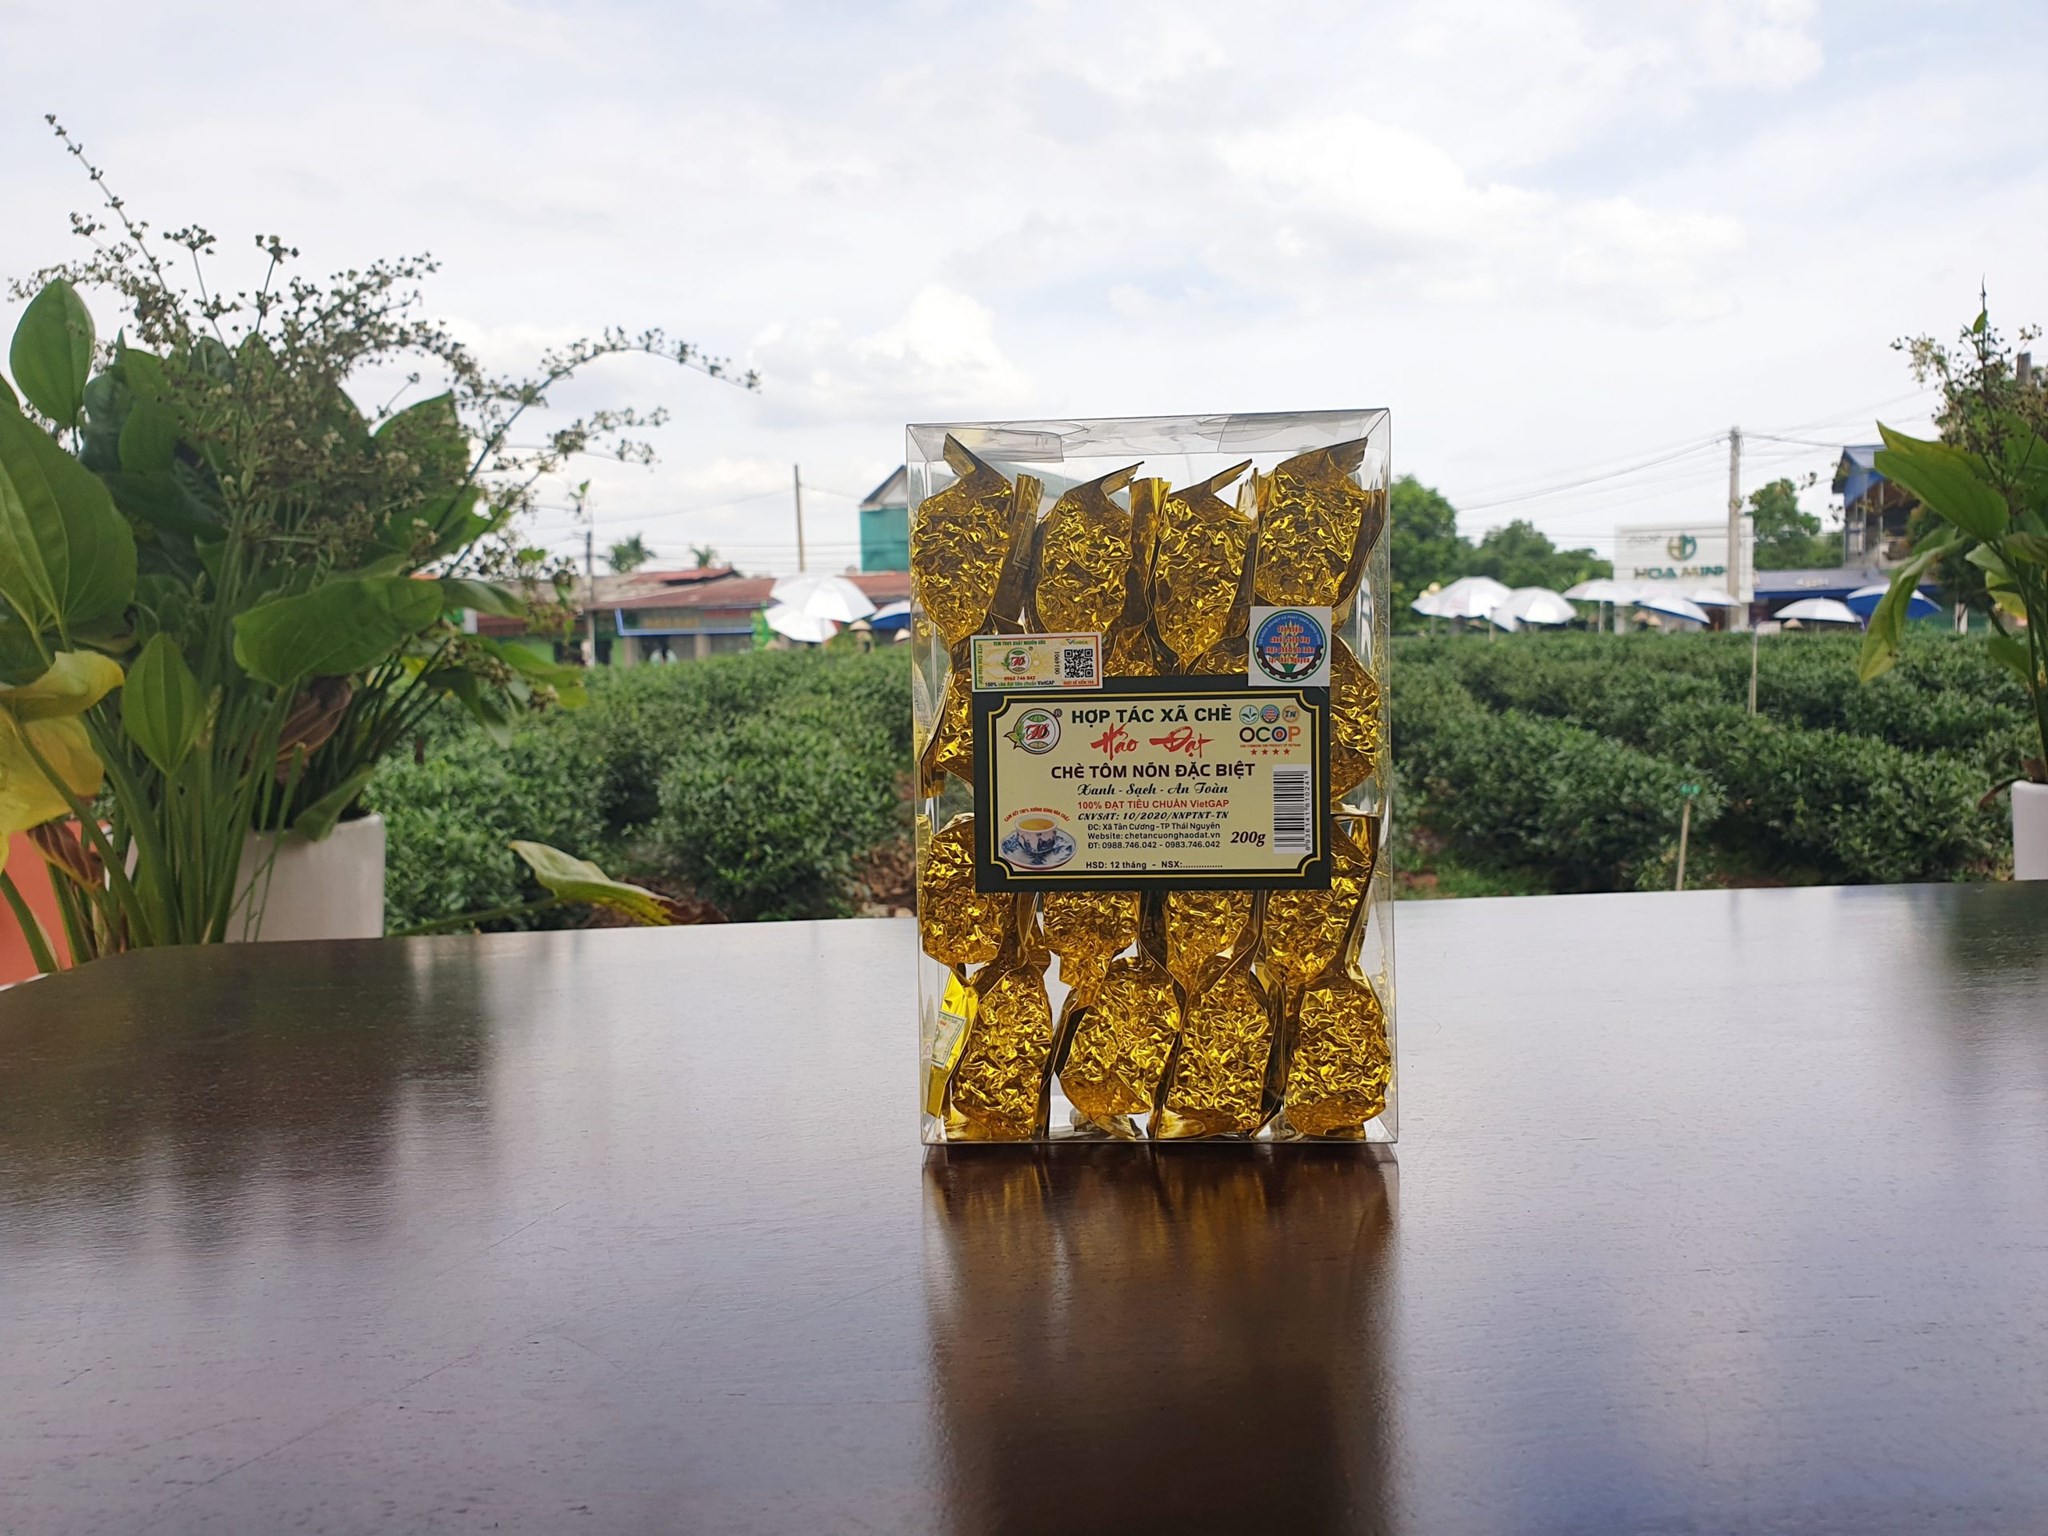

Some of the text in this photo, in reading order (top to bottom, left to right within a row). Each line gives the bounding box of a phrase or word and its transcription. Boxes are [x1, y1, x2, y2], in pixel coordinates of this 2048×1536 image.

[1634, 567, 1677, 579] HOA
[1072, 704, 1232, 728] HỢP TÁC XÃ CHÈ
[1239, 726, 1301, 743] OCOP
[1051, 760, 1255, 780] CHÈ TÔM NÕN ĐẶC BIỆT
[1077, 784, 1116, 796] Xanh
[1126, 783, 1156, 797] Sạch
[1167, 783, 1189, 794] An
[1193, 782, 1229, 794] Toàn
[1077, 799, 1229, 811] 100% ĐẠT TIÊU CHUẨN VietGAP
[1078, 811, 1229, 821] CNVSAT: 10/2020/NNPTNT-TN
[1088, 823, 1100, 831] ĐC:
[1172, 822, 1188, 830] Thái
[1189, 821, 1220, 831] Nguyên
[1087, 831, 1221, 841] Website: chetancuonghaodat.vn
[1230, 831, 1266, 847] 200g
[1086, 861, 1108, 869] HSD:
[1110, 861, 1120, 869] 12
[1122, 860, 1147, 870] tháng
